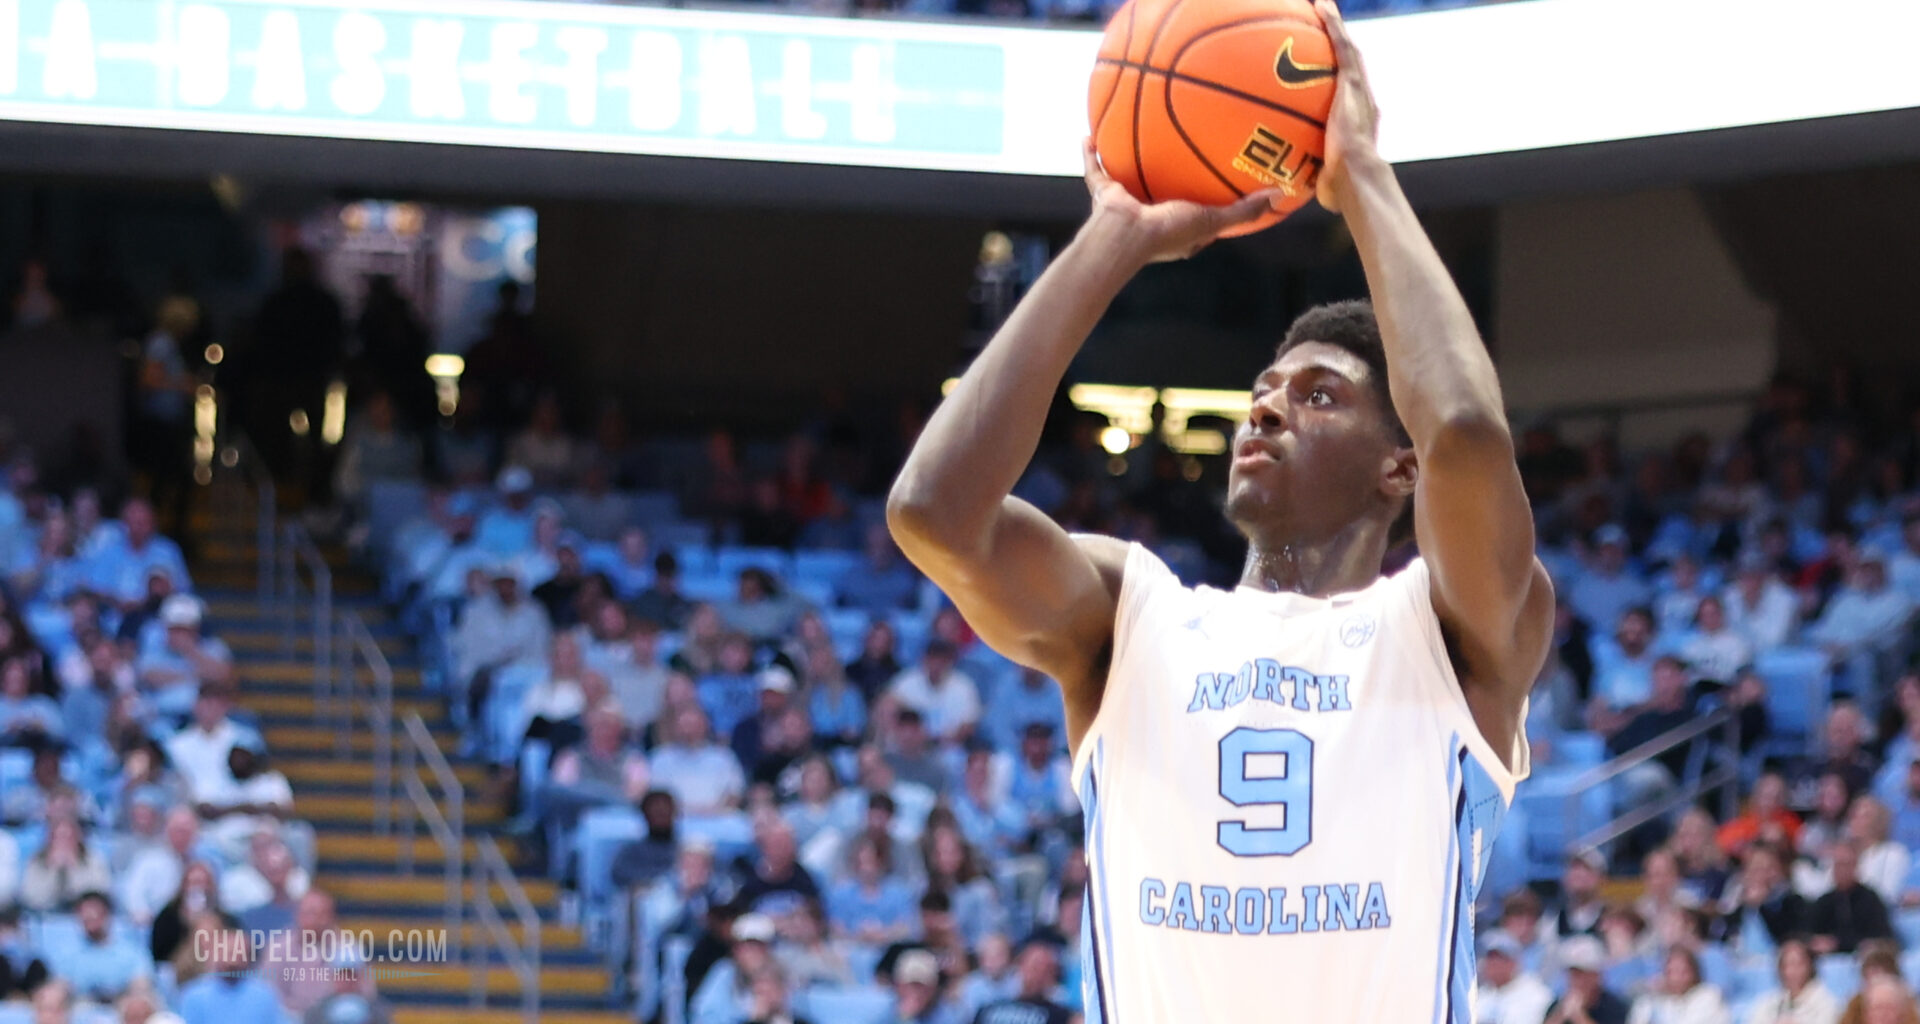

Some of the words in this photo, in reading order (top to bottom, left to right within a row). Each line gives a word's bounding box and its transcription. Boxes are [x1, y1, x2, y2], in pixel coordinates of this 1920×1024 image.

[177, 5, 896, 143] BASKETBALL
[1241, 124, 1325, 189] ELIT
[1187, 657, 1352, 713] NORTH
[1216, 726, 1315, 858] 9
[1138, 876, 1392, 935] CAROLINA
